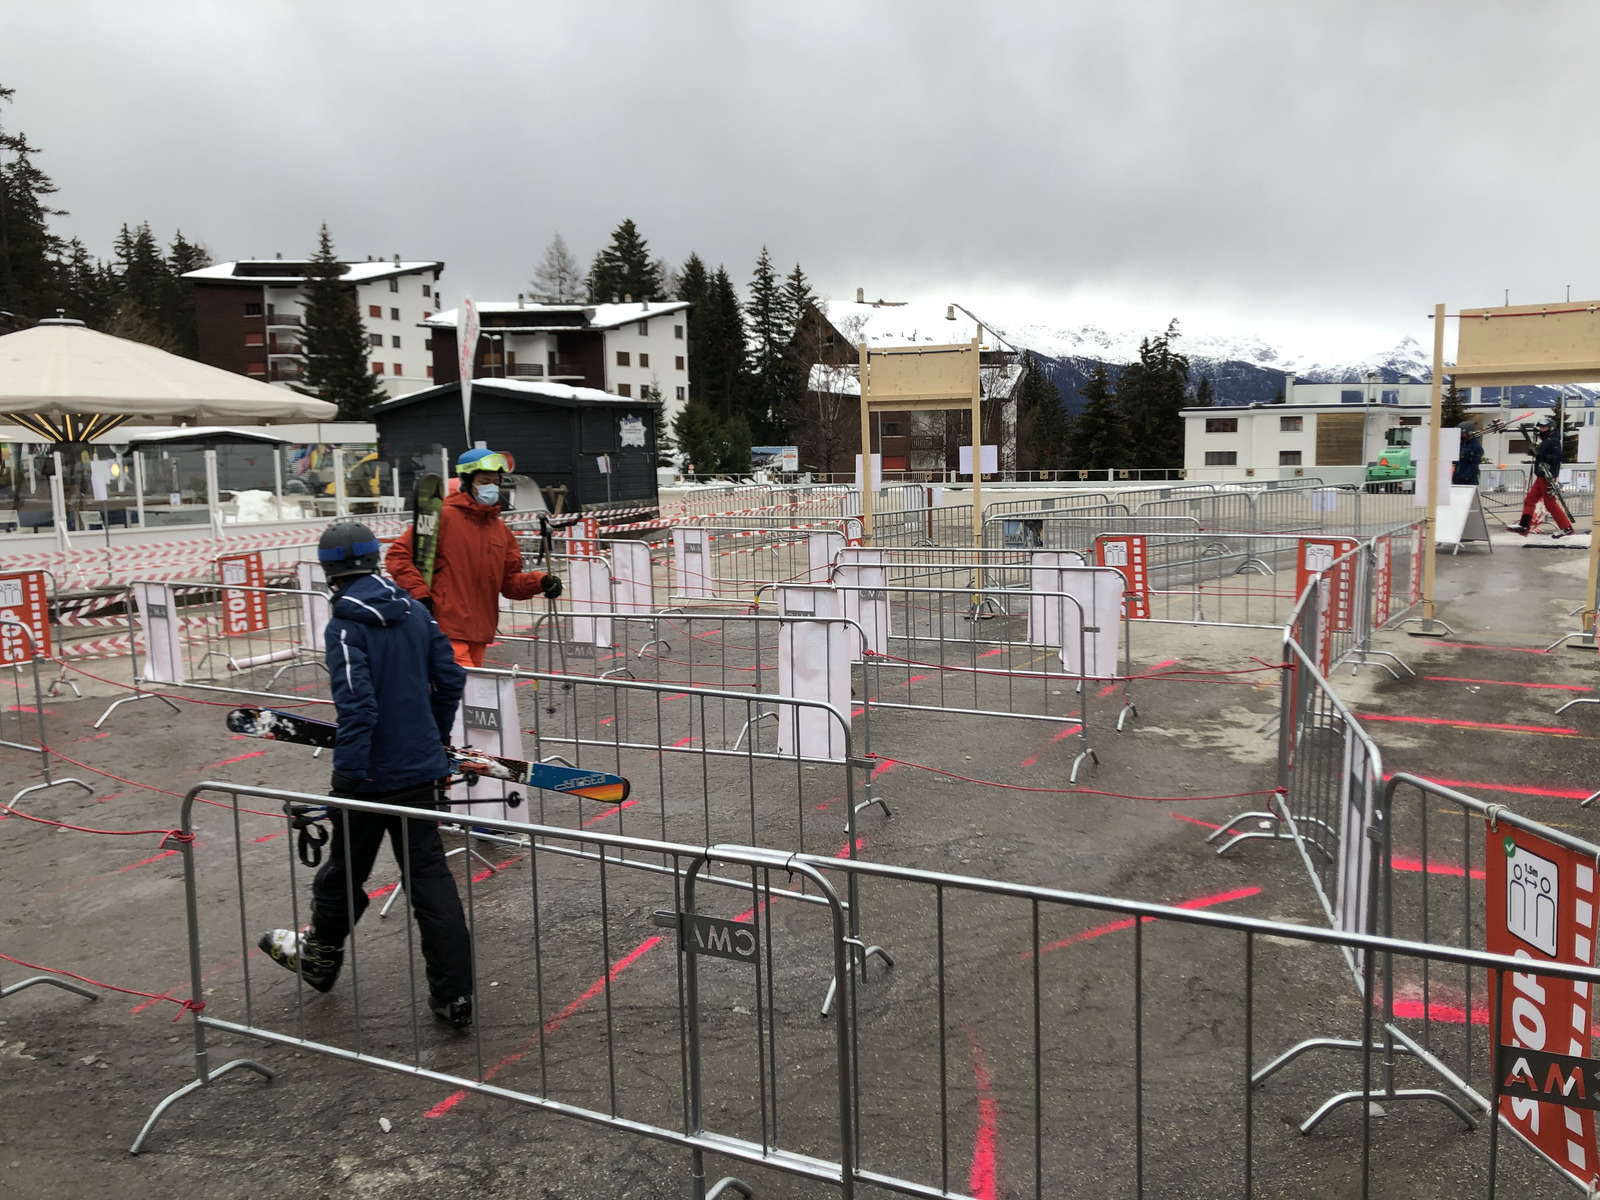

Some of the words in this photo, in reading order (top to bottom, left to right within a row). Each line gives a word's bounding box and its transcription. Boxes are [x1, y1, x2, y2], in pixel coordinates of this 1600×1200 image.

[227, 587, 249, 632] STOP
[0, 609, 24, 661] STOP
[566, 644, 594, 657] CMA
[1511, 948, 1546, 1136] SOP
